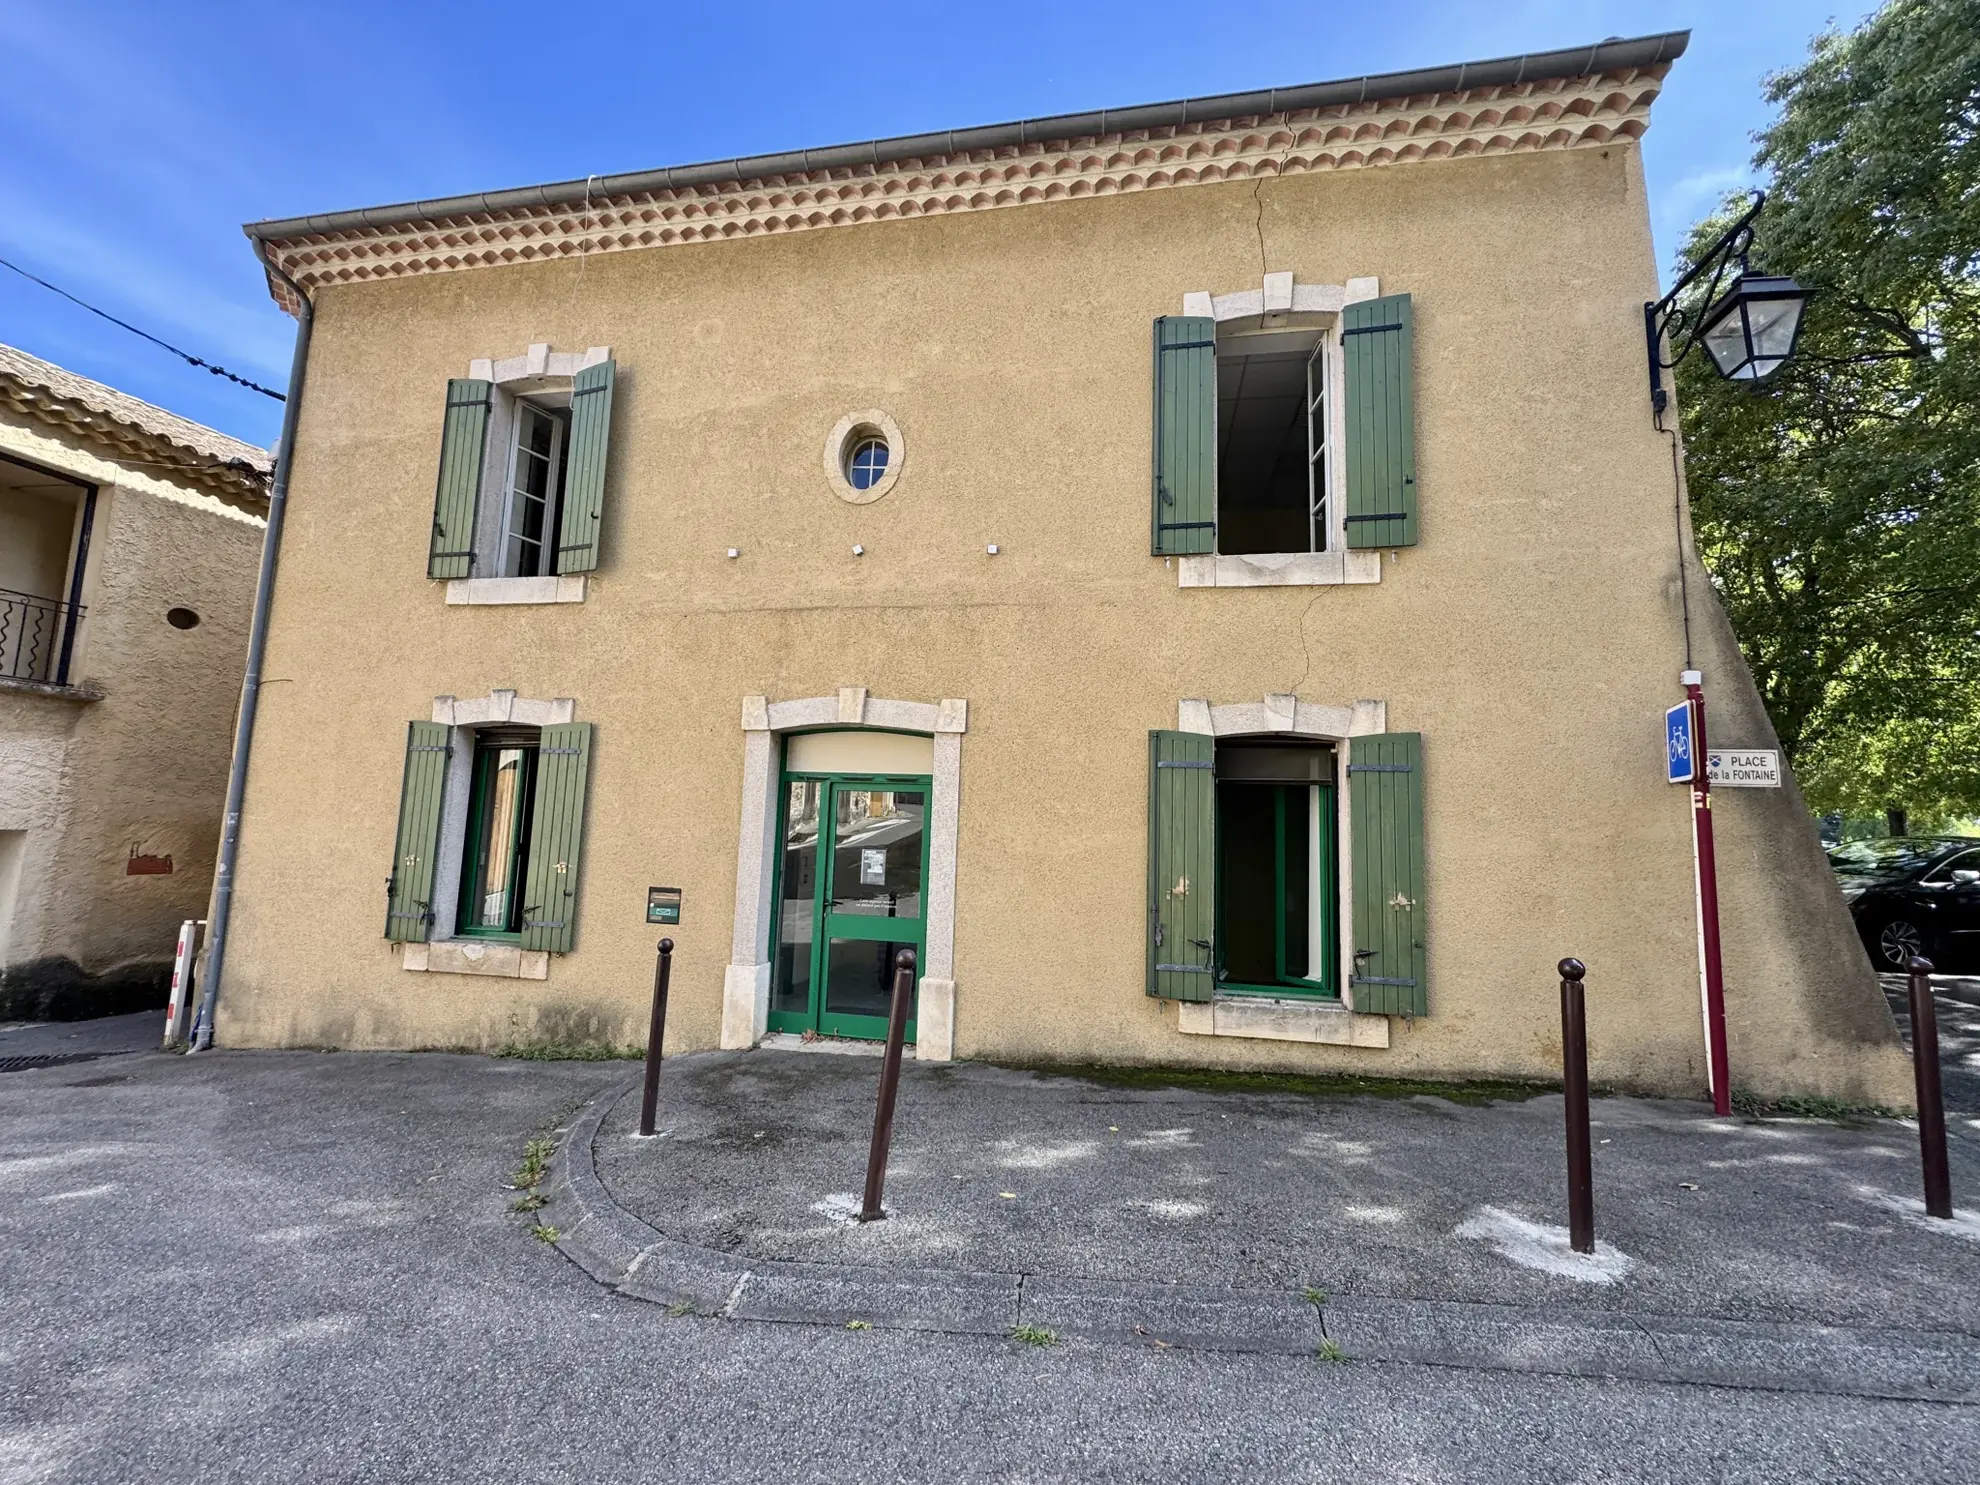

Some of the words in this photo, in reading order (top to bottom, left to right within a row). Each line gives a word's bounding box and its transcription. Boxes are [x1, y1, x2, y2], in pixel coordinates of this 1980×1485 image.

[1731, 756, 1767, 767] PLACE
[1708, 770, 1719, 780] de
[1721, 770, 1730, 780] la
[1732, 770, 1776, 780] FONTAINE
